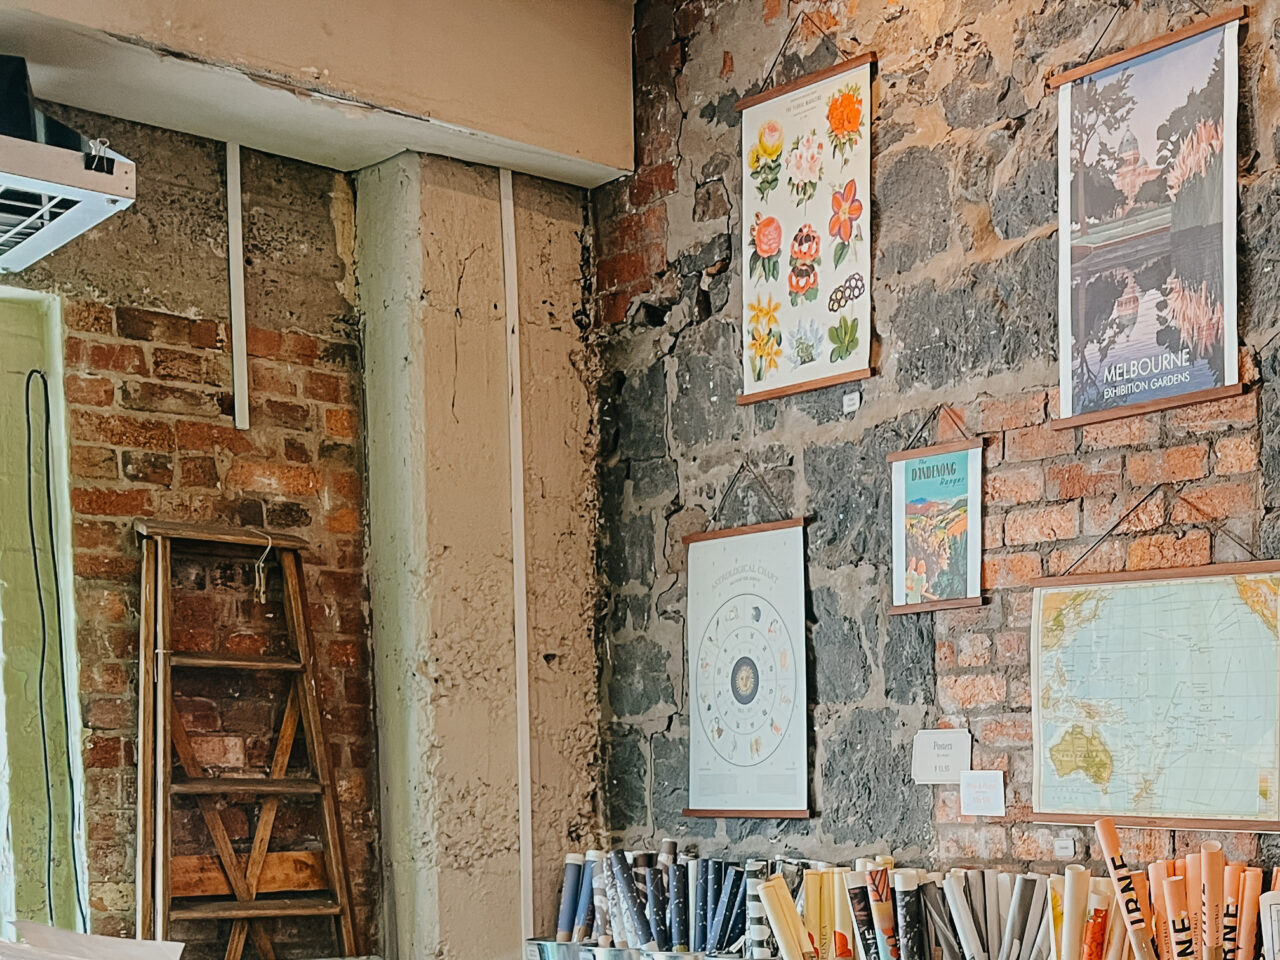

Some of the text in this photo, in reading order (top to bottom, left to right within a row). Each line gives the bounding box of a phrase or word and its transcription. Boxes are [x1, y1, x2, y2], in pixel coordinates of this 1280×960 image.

[1103, 348, 1190, 383] MELBOURNE
[1103, 371, 1190, 399] EXHIBITION GARDENS
[911, 461, 957, 482] DANDENONG
